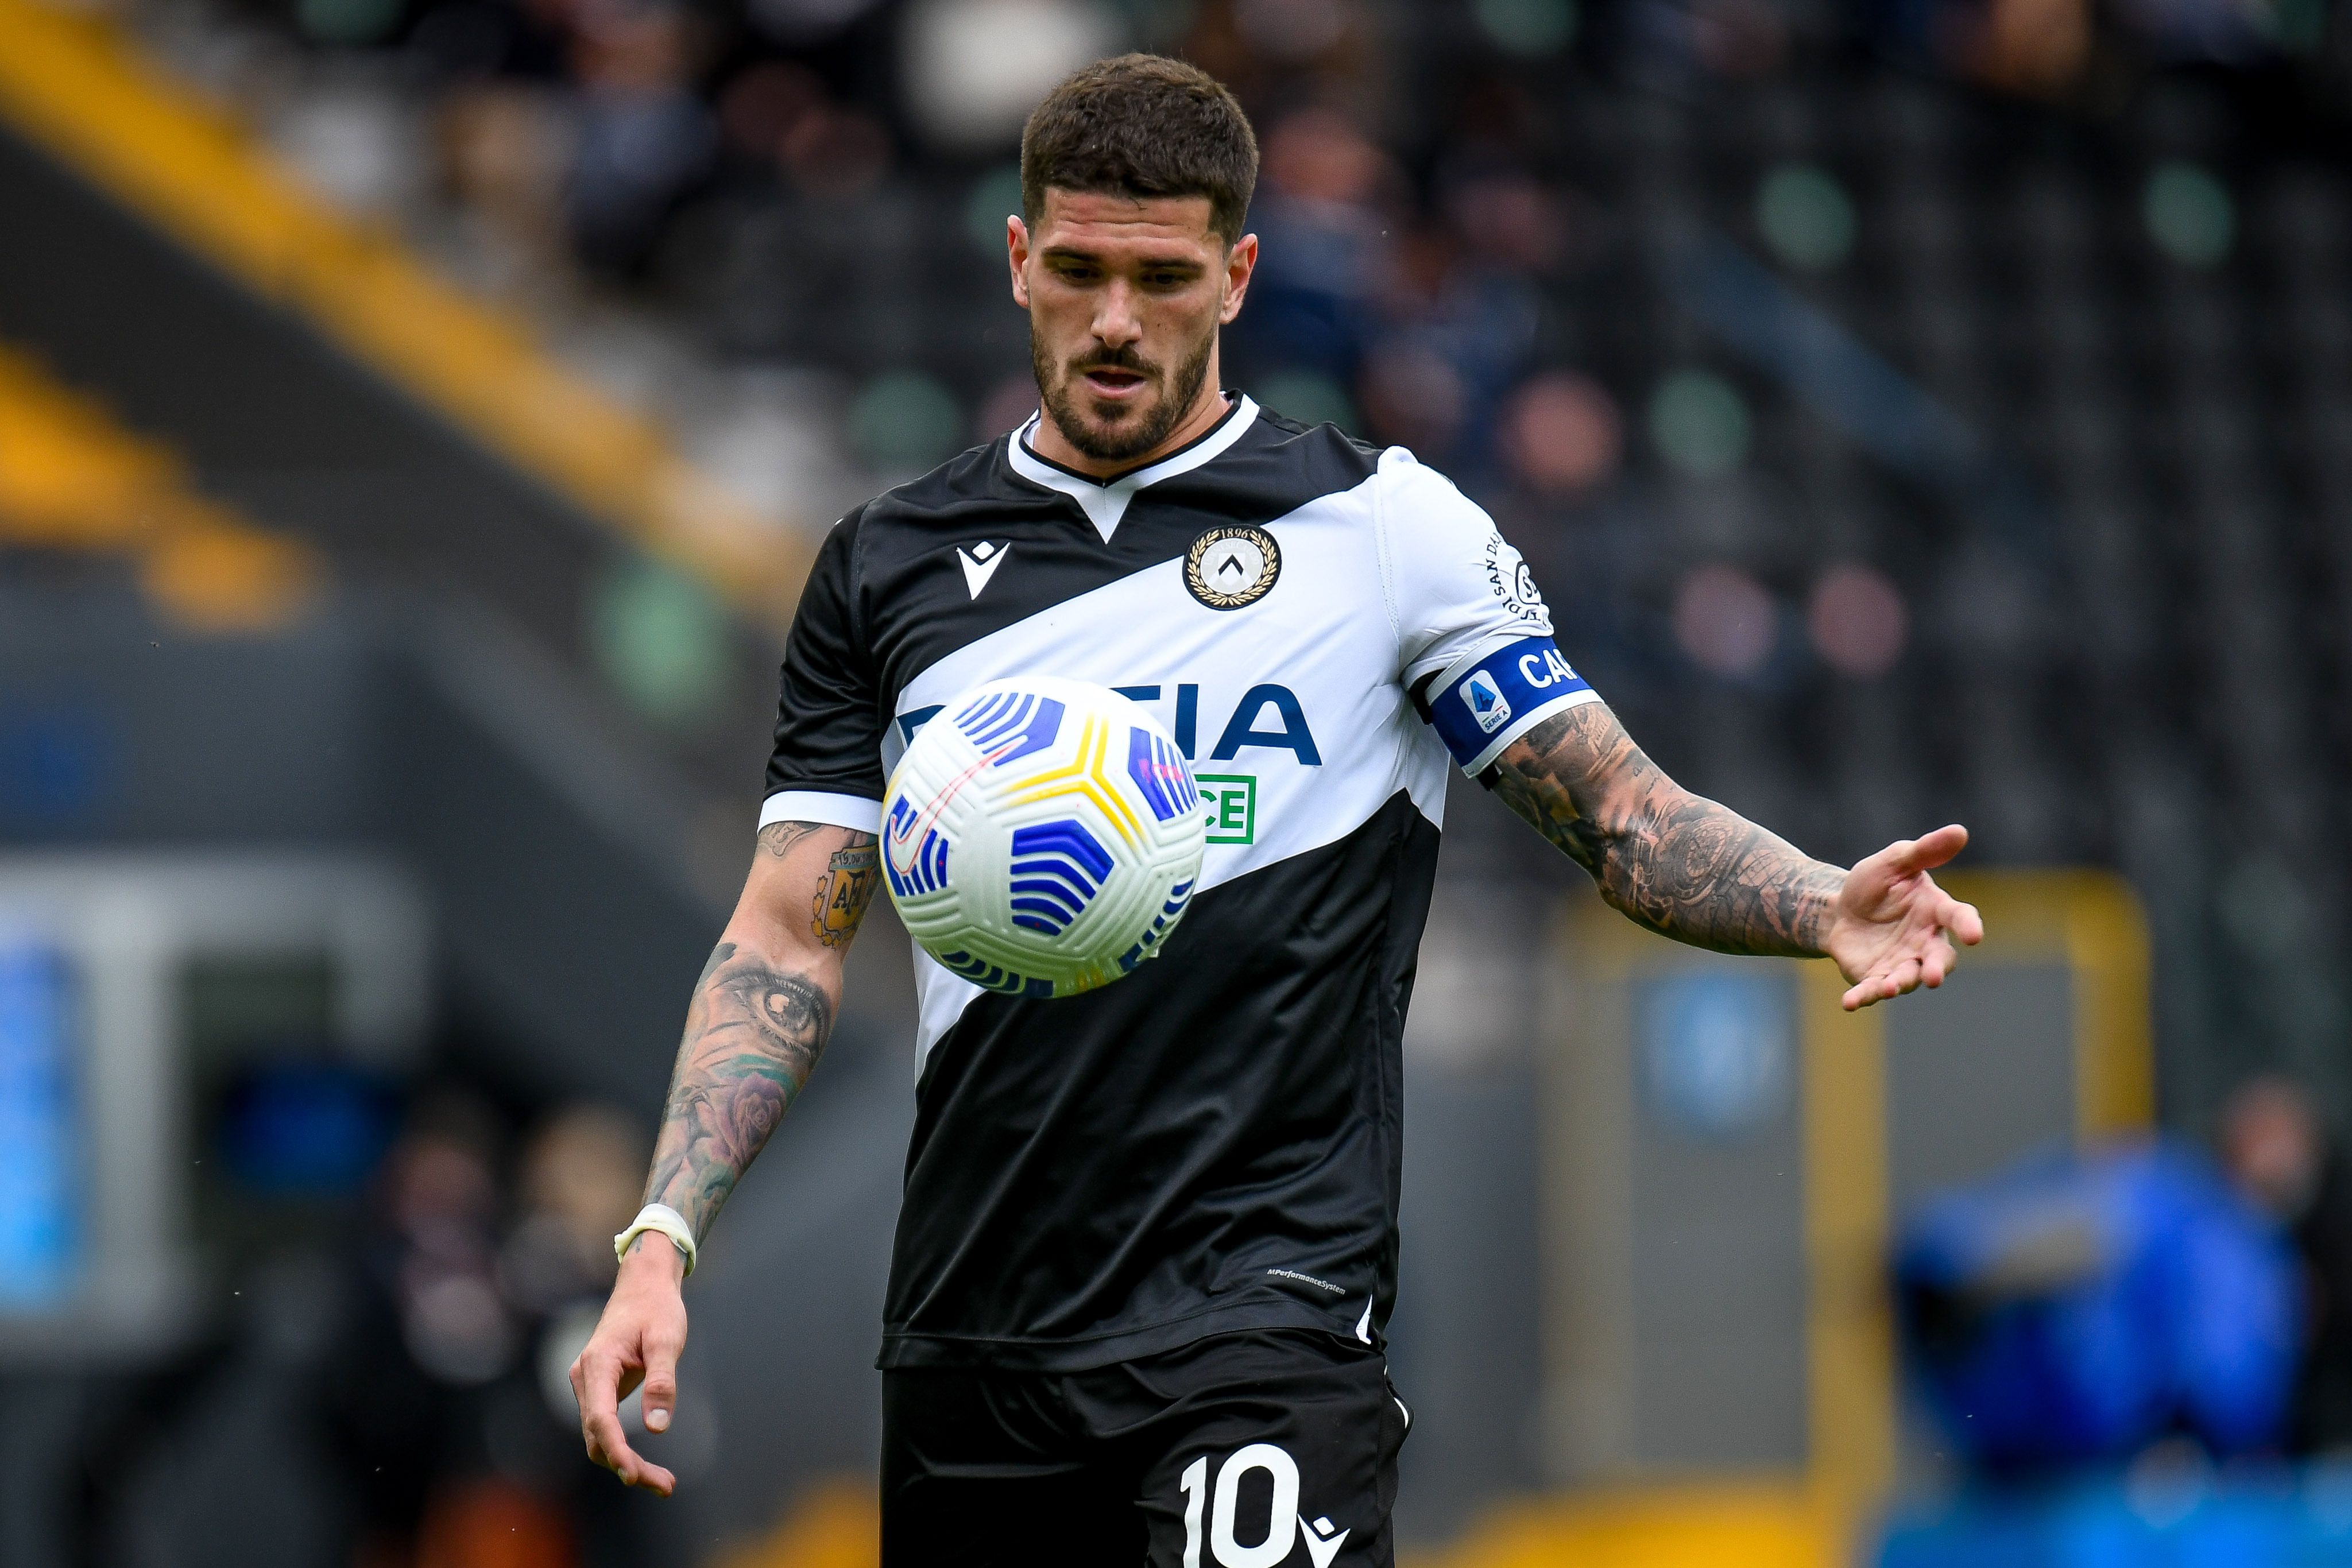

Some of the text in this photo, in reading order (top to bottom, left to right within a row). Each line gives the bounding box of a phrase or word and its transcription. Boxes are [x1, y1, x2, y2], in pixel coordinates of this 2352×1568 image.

[1220, 528, 1250, 539] 1896
[1486, 557, 1506, 596] SAN
[1485, 710, 1508, 730] SERIE A
[1267, 1268, 1346, 1295] MPerformanceSystem
[1180, 1443, 1299, 1568] 10
